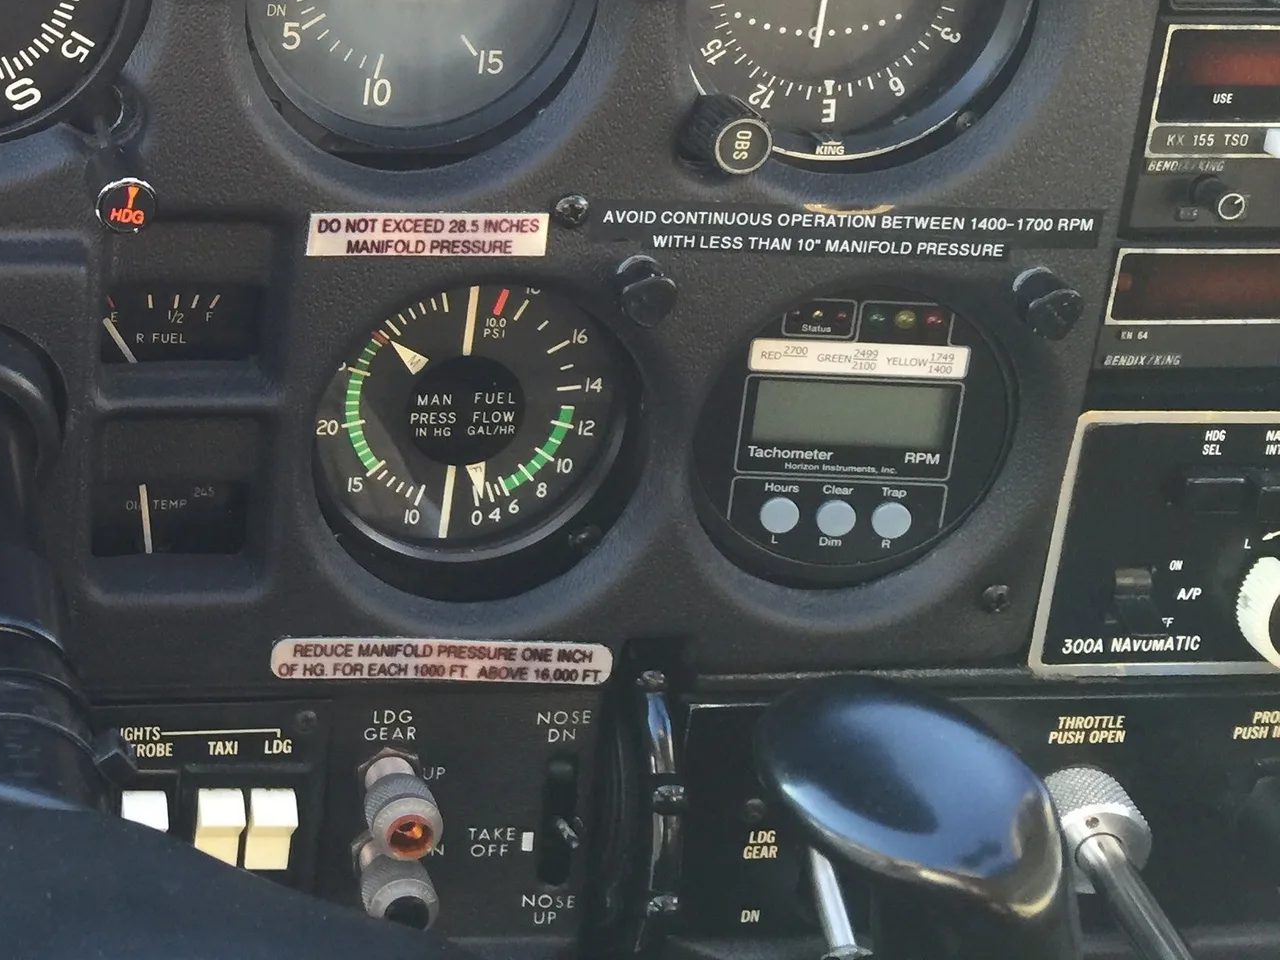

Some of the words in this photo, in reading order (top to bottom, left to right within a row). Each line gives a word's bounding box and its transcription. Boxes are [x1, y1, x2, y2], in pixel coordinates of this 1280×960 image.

[266, 4, 286, 17] DN
[5, 77, 41, 110] S
[1213, 93, 1233, 105] USE
[733, 130, 752, 161] OBS
[1167, 134, 1185, 146] KX
[1193, 134, 1215, 146] 155
[1224, 134, 1249, 146] TSO
[816, 144, 845, 155] KING
[1148, 160, 1224, 172] BENDIX/KING
[109, 207, 145, 225] HDG
[603, 210, 658, 225] AVOID
[661, 211, 772, 227] CONTINUOUS
[778, 213, 876, 229] OPERATION
[881, 215, 965, 230] BETWEEN
[971, 217, 1054, 232] 1400-1700
[1058, 218, 1094, 232] RPM
[318, 220, 341, 233] DO
[345, 219, 377, 233] NOT
[382, 219, 444, 233] EXCEED
[449, 220, 479, 233] 28.5
[484, 219, 540, 233] INCHES
[347, 240, 426, 255] MANIFOLD
[430, 240, 512, 254] PRESSURE
[653, 234, 695, 249] WITH
[700, 235, 743, 250] LESS
[749, 237, 791, 251] THAN
[797, 238, 821, 251] 10"
[826, 239, 912, 256] MANIFOLD
[917, 241, 1004, 257] PRESSURE
[136, 333, 145, 343] R
[152, 333, 187, 344] FUEL
[573, 329, 588, 344] 16
[760, 351, 782, 361] RED
[783, 345, 809, 356] 2700
[817, 352, 852, 364] GREEN
[853, 349, 879, 360] 2499
[886, 356, 928, 368] YELLOW
[930, 352, 955, 363] 1749
[851, 360, 876, 371] 2100
[927, 364, 953, 375] 1400
[417, 394, 452, 406] MAN
[474, 393, 516, 405] FUEL
[410, 413, 457, 424] PRESS
[473, 412, 515, 423] FLOW
[316, 421, 339, 436] 20
[1205, 430, 1226, 442] HDG
[747, 445, 834, 461] Tachometer
[904, 452, 941, 466] RPM
[1202, 445, 1222, 456] SEL
[784, 462, 820, 472] Horizon
[822, 463, 879, 475] Instruments,
[881, 465, 898, 475] Inc.
[764, 481, 800, 494] Hours
[822, 484, 854, 496] Clear
[1177, 587, 1202, 601] A/P
[1062, 638, 1103, 654] 300A
[293, 644, 353, 658] REDUCE
[358, 644, 433, 658] MANIFOLD
[437, 645, 517, 660] PRESSURE
[521, 647, 553, 661] ONE
[557, 648, 594, 663] INCH
[372, 710, 413, 725] LDG
[536, 710, 592, 725] NOSE
[1058, 715, 1126, 730] THROTTLE
[364, 727, 416, 741] GEAR
[547, 728, 576, 742] DN
[1048, 731, 1085, 745] PUSH
[1089, 730, 1126, 744] OPEN
[208, 741, 239, 757] TAXI
[264, 740, 292, 755] LDG
[468, 827, 516, 841] TAKE
[470, 843, 509, 858] OFF
[521, 894, 576, 910] NOSE
[533, 911, 557, 925] UP
